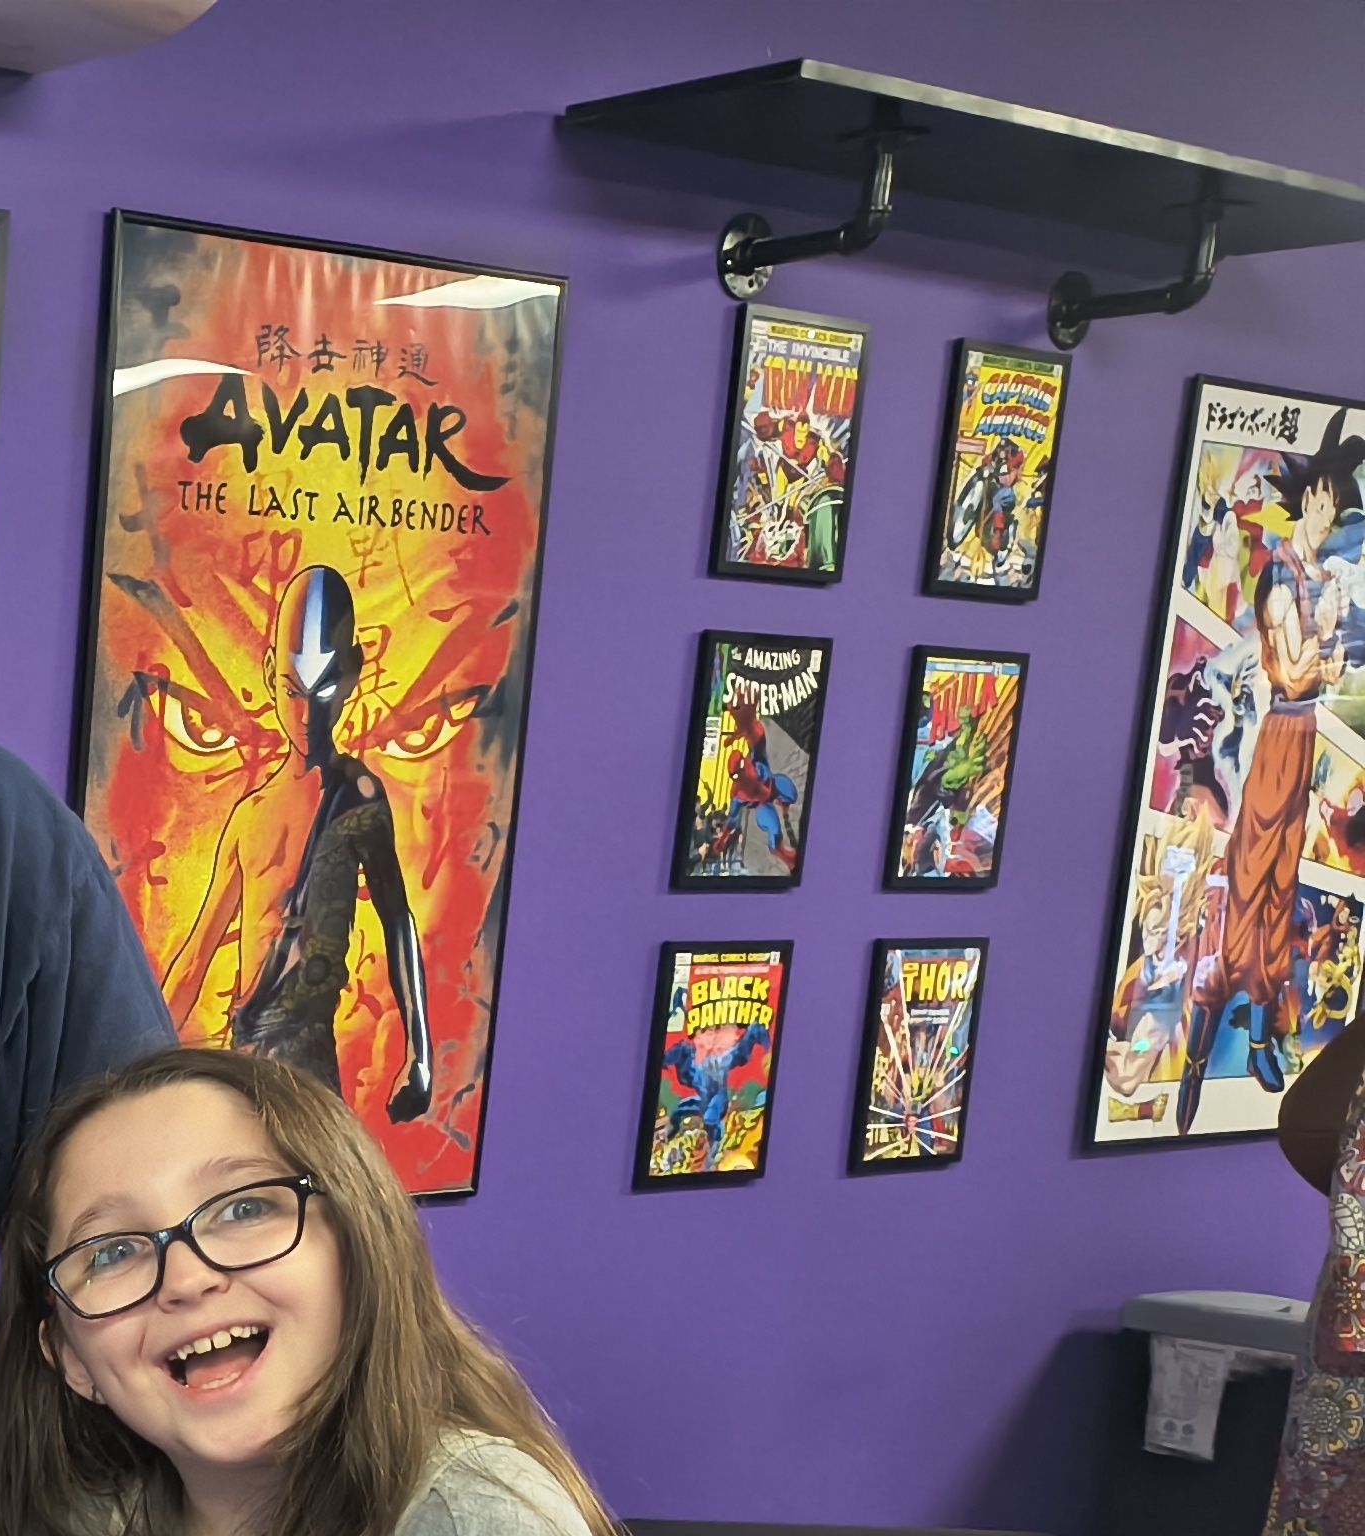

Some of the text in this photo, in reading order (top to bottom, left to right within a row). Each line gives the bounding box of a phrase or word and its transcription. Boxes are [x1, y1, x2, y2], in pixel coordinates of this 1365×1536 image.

[763, 355, 860, 418] IRON MAN
[180, 371, 512, 493] AVATAR
[177, 480, 491, 537] THE LAST AIRBENDER
[744, 647, 801, 671] AMAZING
[723, 666, 819, 716] SPIDER-MAN
[691, 975, 771, 1007] BLACK
[902, 961, 970, 1003] THOR
[686, 999, 774, 1037] PANTHER
